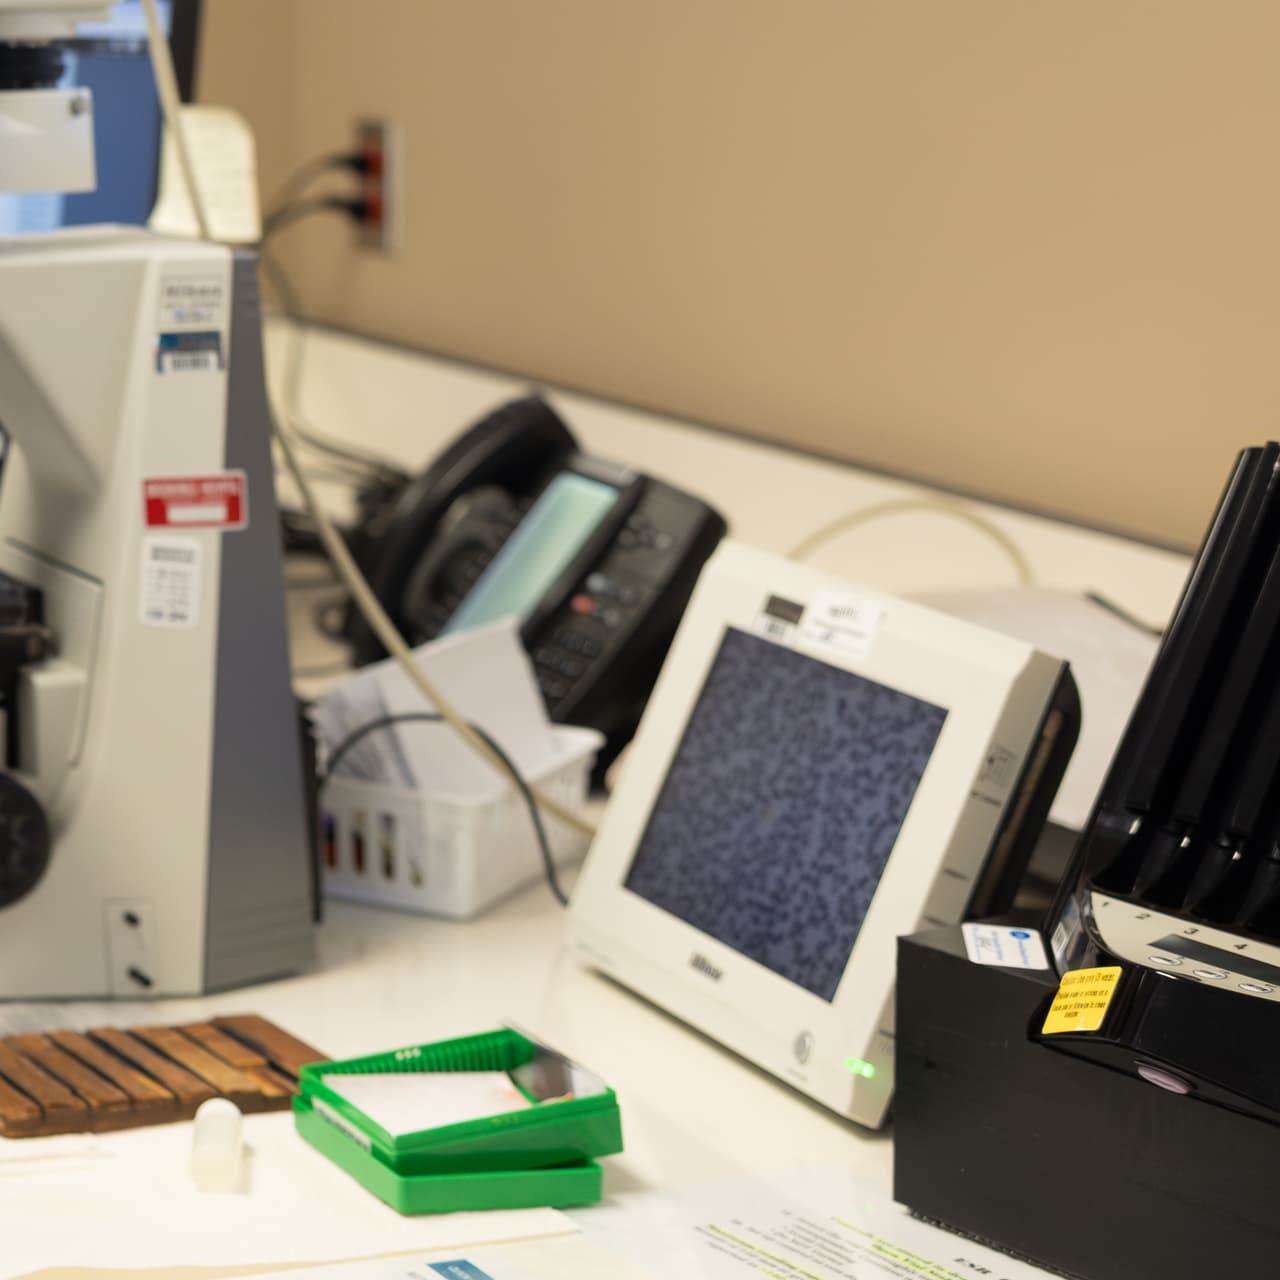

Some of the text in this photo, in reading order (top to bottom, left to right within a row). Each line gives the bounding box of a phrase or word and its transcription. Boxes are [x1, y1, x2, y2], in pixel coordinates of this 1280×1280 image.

[1135, 912, 1151, 920] 2
[1184, 927, 1200, 936] 3
[1233, 943, 1248, 951] 4
